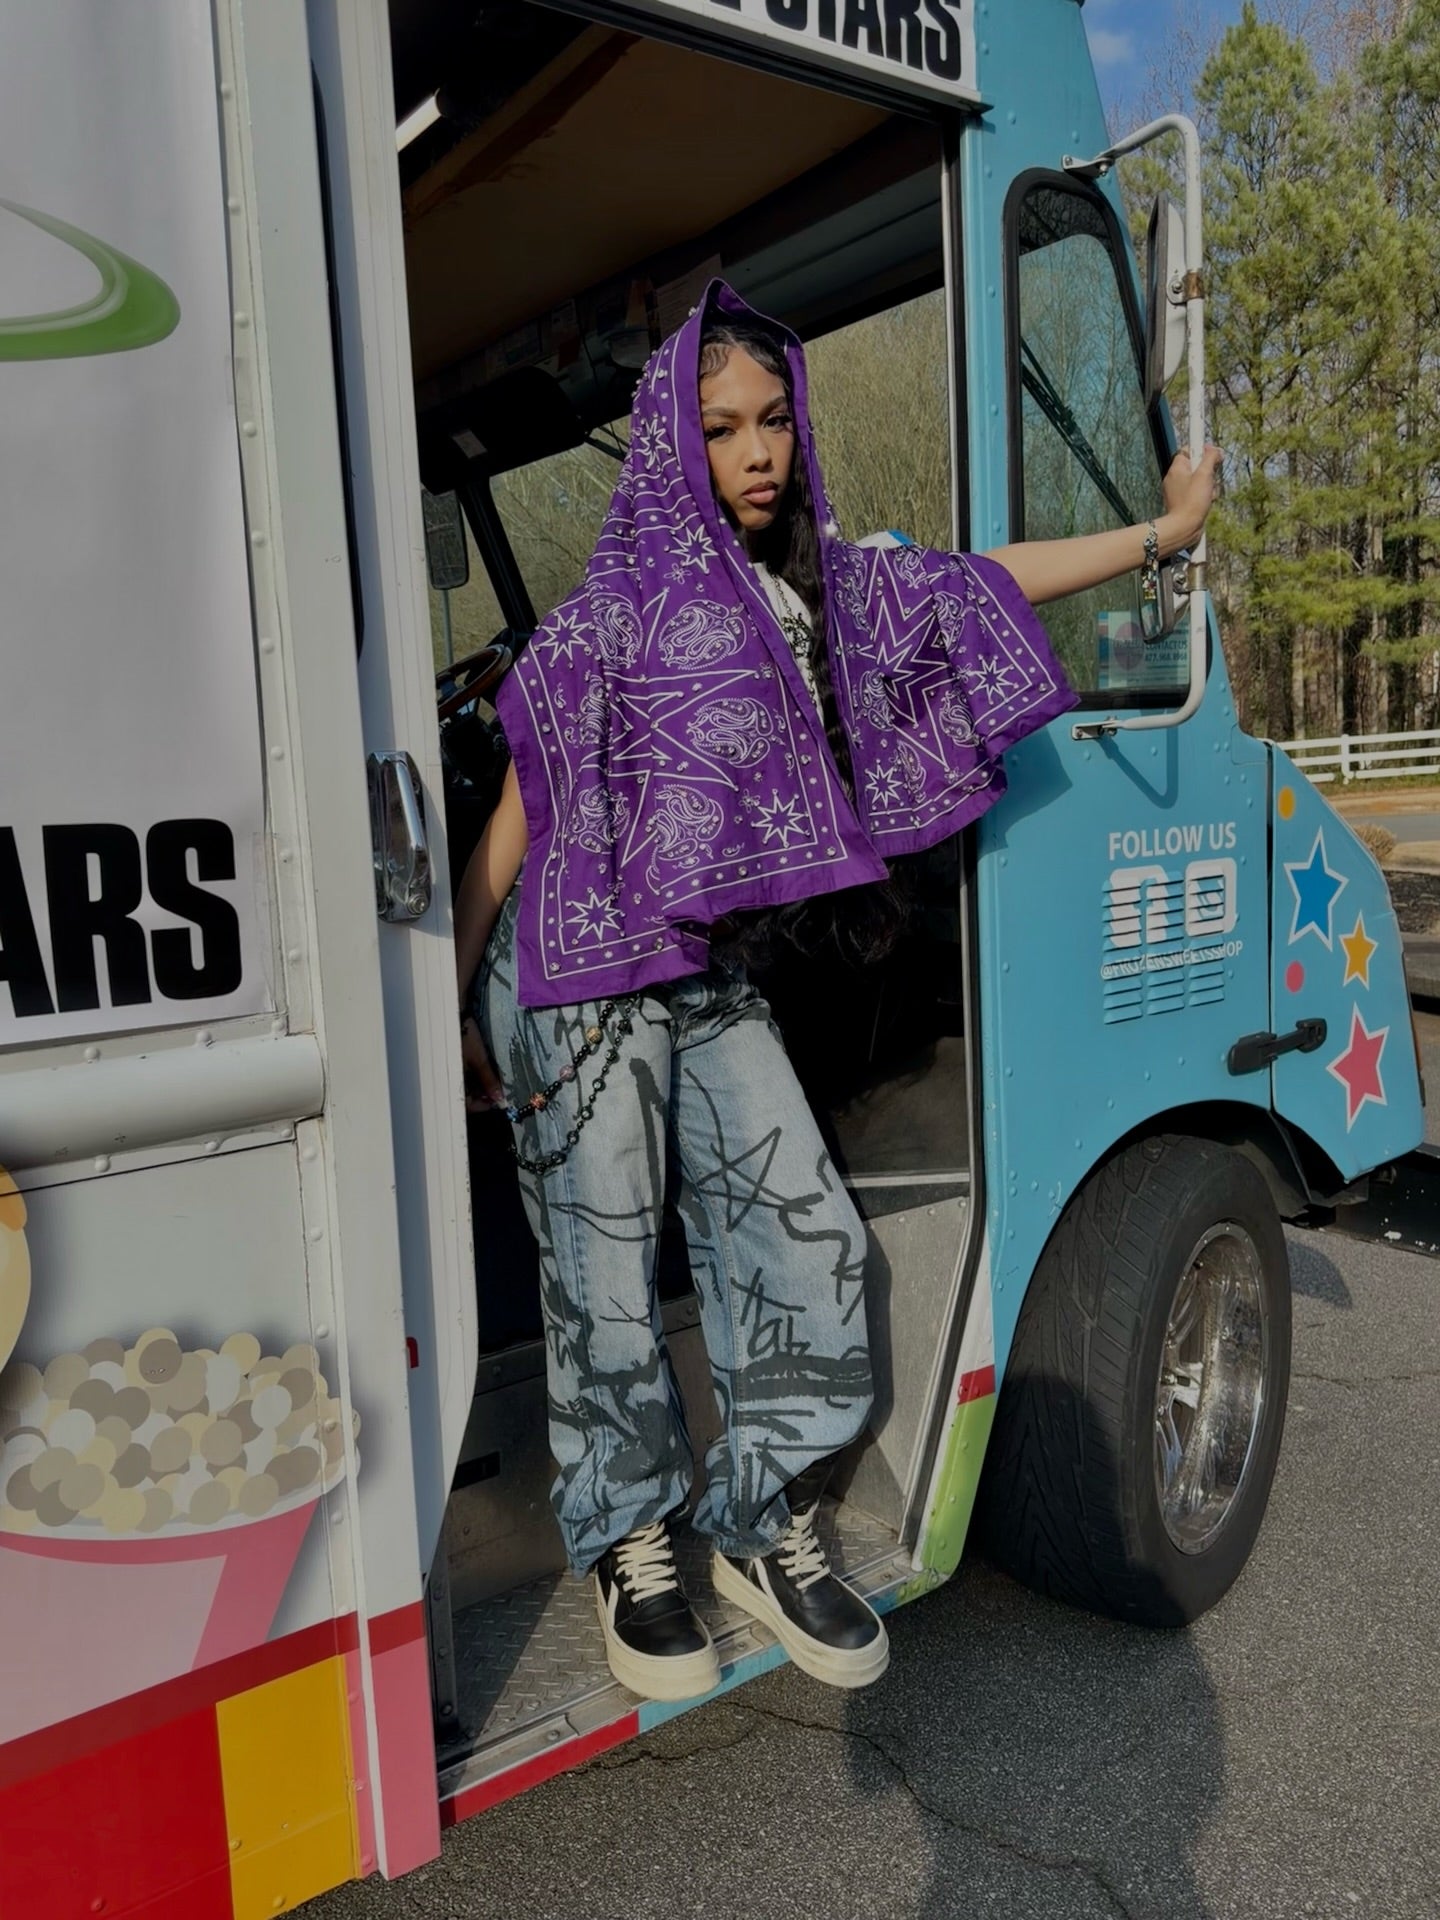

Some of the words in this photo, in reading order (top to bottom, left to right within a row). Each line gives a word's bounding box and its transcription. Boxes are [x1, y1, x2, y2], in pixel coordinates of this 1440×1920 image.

[765, 0, 961, 81] ARS
[1109, 825, 1203, 860] FOLLOW
[1209, 822, 1236, 850] US
